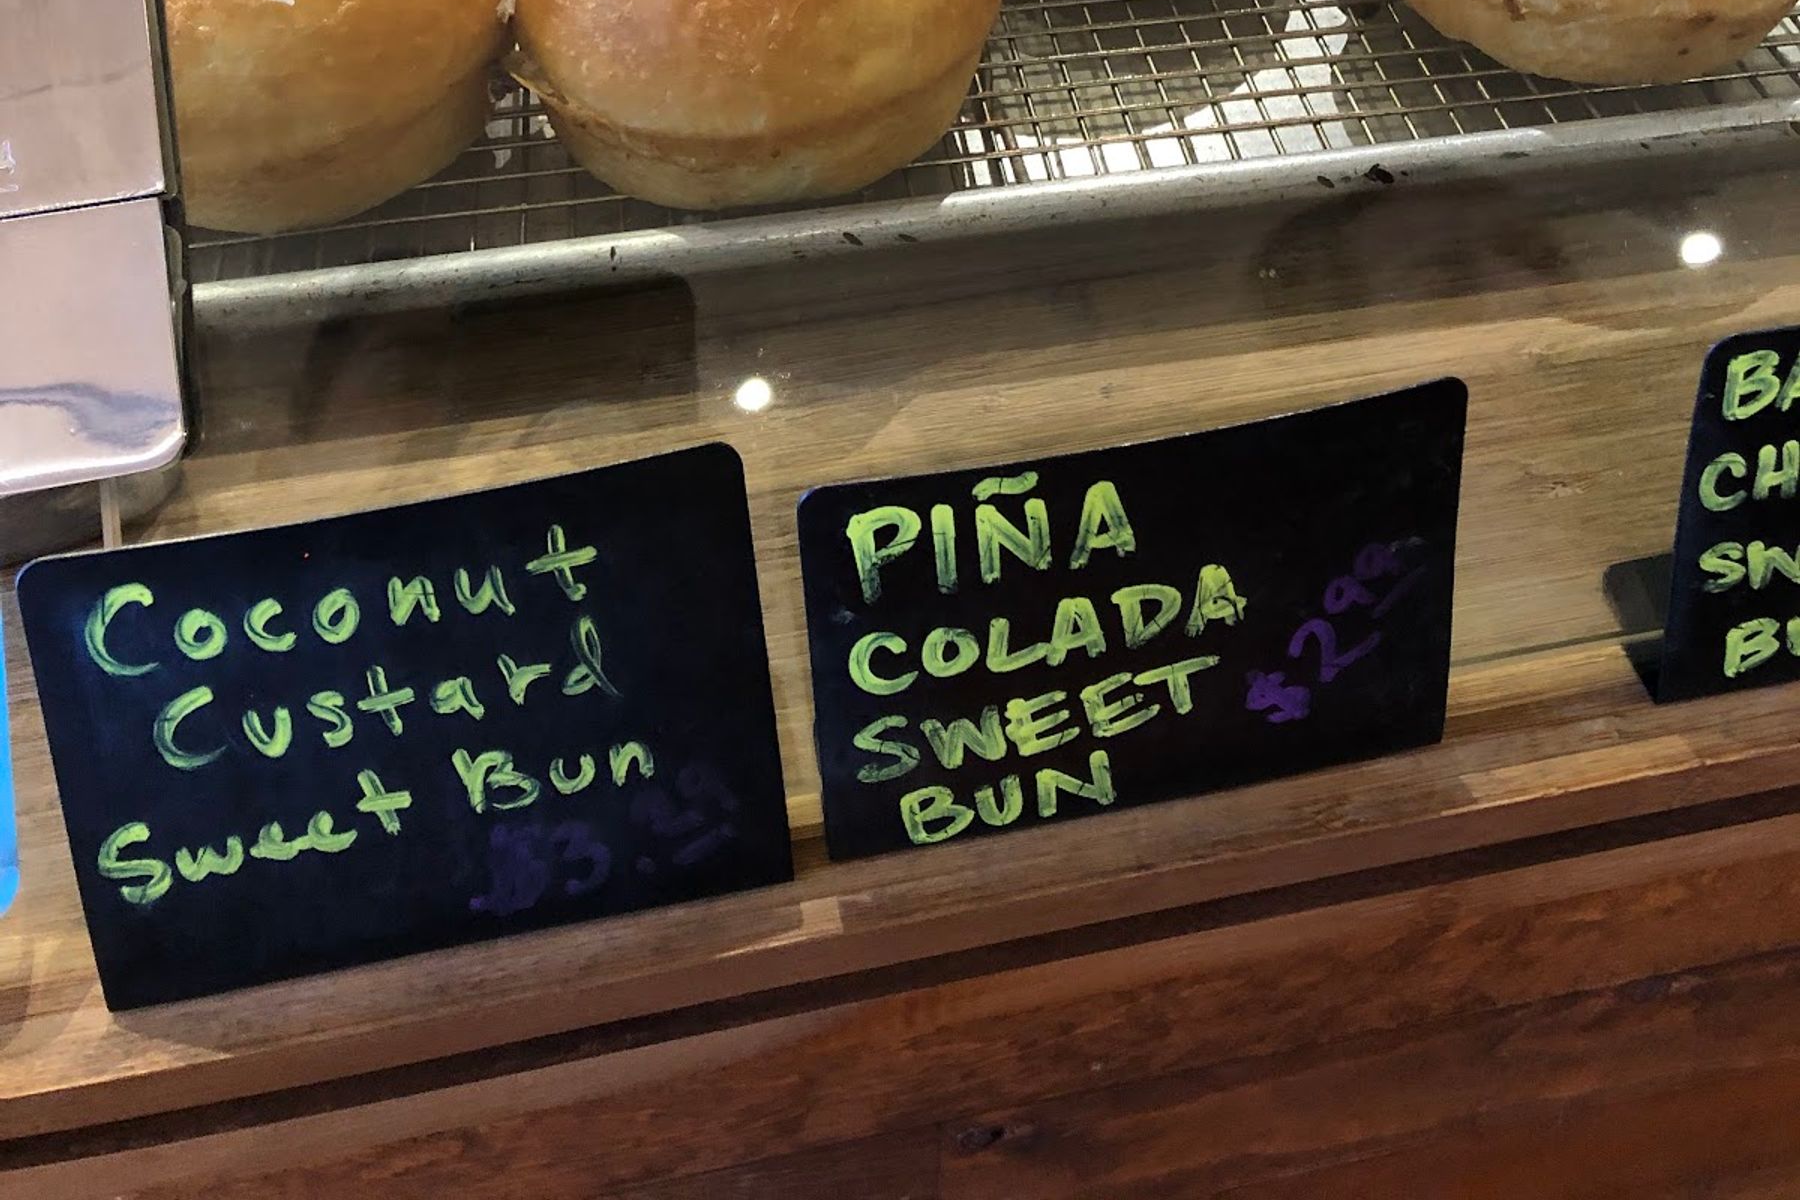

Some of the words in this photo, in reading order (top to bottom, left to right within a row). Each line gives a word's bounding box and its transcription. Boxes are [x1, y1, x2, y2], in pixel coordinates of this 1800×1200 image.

[85, 525, 597, 677] Coconut
[846, 471, 1136, 602] PIÑA
[154, 615, 623, 770] Custard
[848, 563, 1248, 695] COLADA
[853, 655, 1220, 783] SWEET
[99, 769, 413, 904] Sweet
[451, 740, 654, 813] Bun
[899, 749, 1115, 846] BUN
